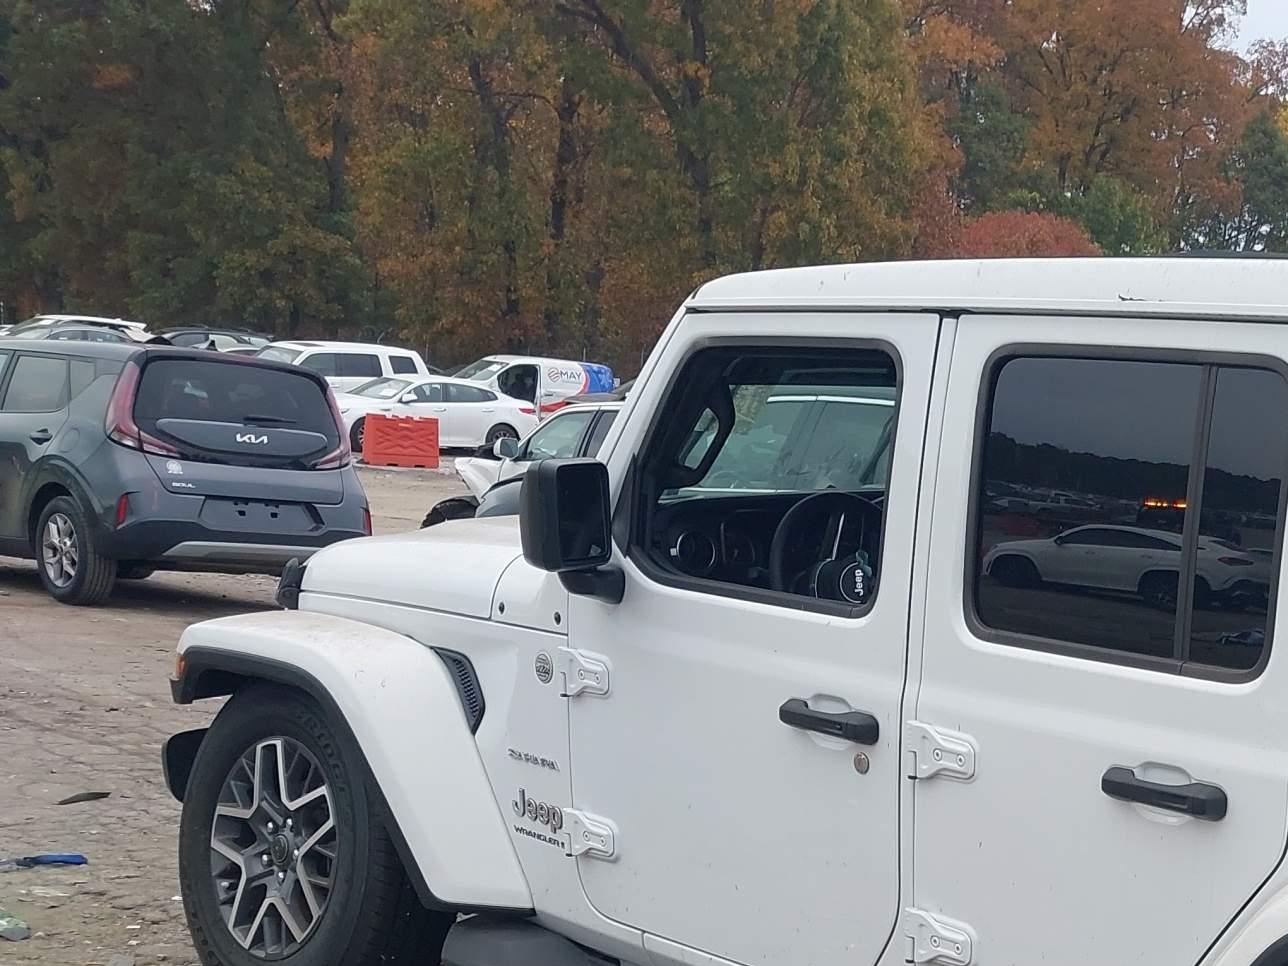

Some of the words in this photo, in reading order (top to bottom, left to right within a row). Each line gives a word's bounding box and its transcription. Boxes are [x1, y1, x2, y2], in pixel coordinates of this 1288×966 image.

[560, 370, 582, 380] MAY
[854, 569, 864, 596] Jeep
[512, 788, 563, 834] Jeep
[514, 825, 560, 847] WRANGLER
